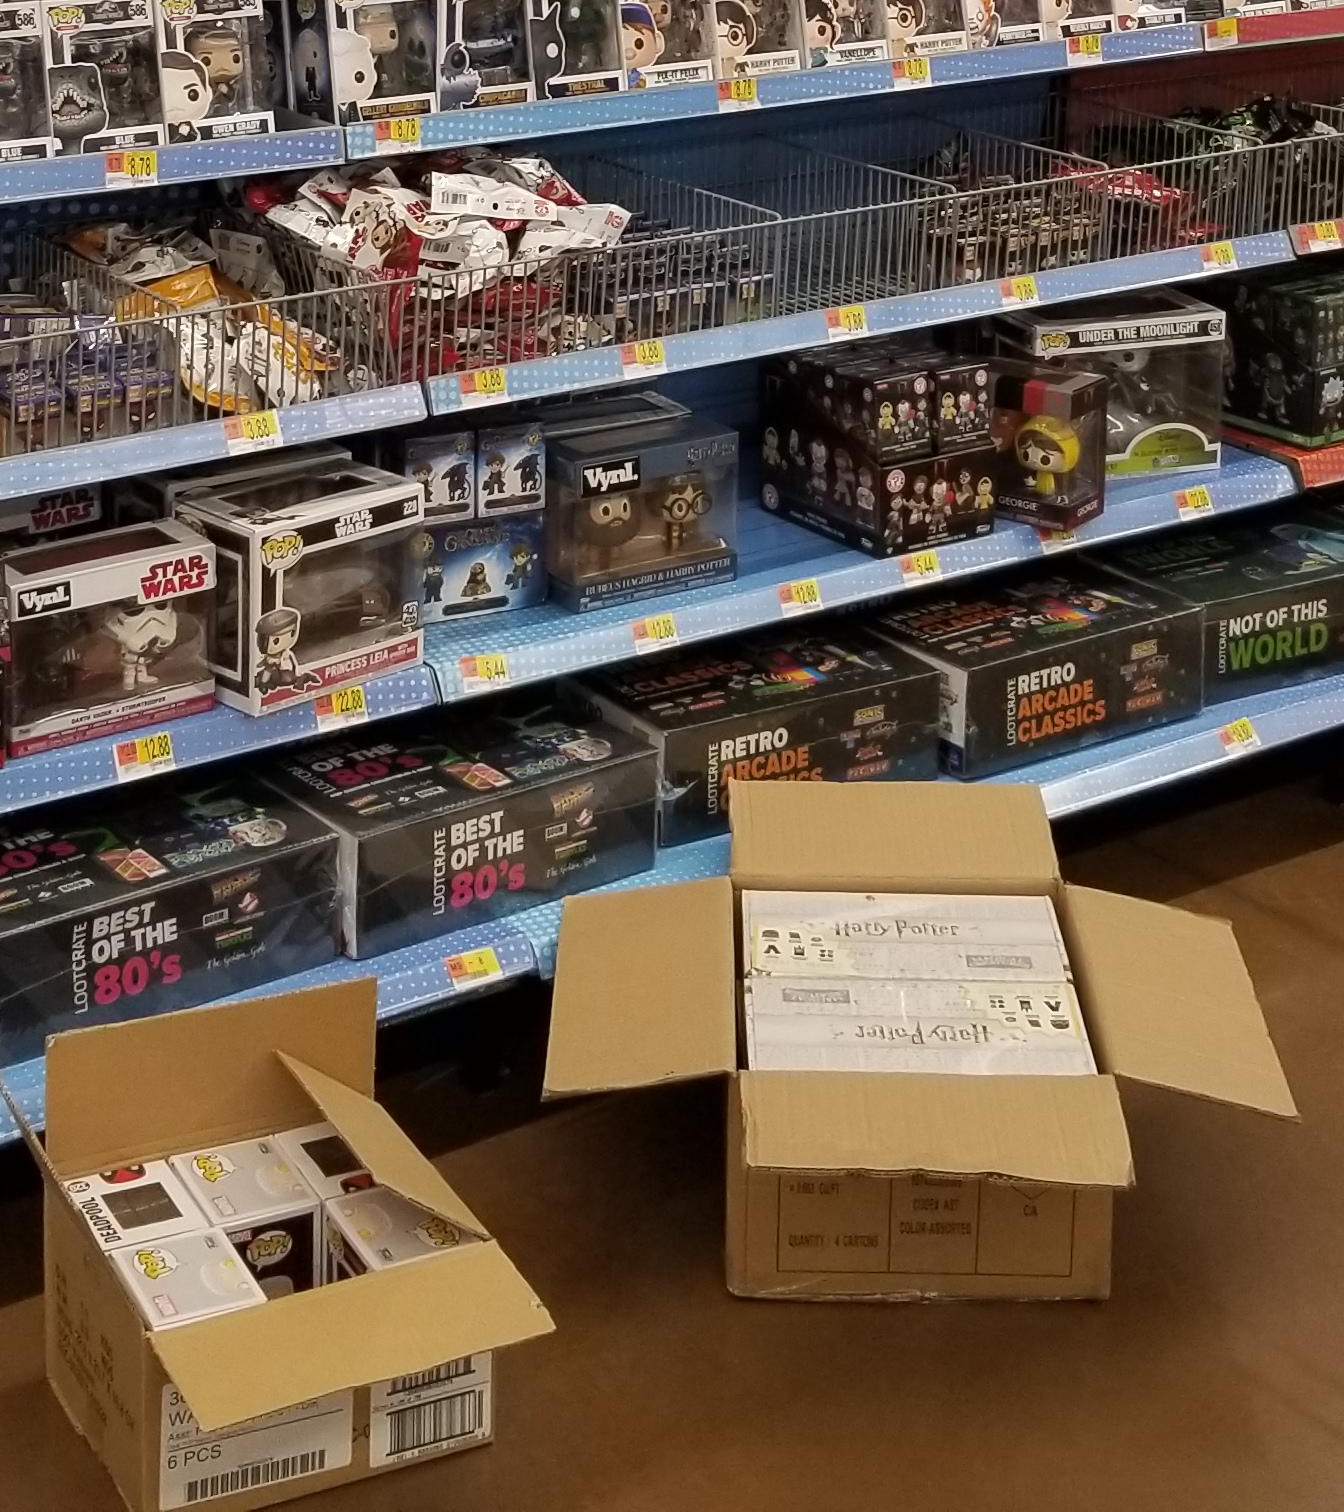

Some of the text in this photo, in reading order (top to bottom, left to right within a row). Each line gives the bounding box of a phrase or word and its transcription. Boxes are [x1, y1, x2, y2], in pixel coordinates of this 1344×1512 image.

[129, 155, 152, 176] 8.78
[1079, 322, 1200, 343] UNDER THE MOONLIGHT
[248, 418, 270, 439] 3.88
[584, 461, 638, 492] Vynl.
[999, 496, 1039, 511] GEORGIE
[141, 554, 209, 581] STAR
[696, 558, 731, 574] POTTER
[20, 584, 71, 612] Vynl.
[141, 571, 209, 600] WARS
[1229, 599, 1329, 637] NOT OF THIS
[325, 649, 389, 679] PRINCESS LEIA
[1218, 618, 1228, 675] LOOTCRATE
[1229, 622, 1329, 671] WORLD
[1017, 662, 1076, 696] RETRO
[1006, 677, 1017, 746] LOOTCRATE
[1018, 679, 1095, 720] ARCADE
[1018, 700, 1107, 744] CLASSICS
[145, 737, 171, 760] 12.88
[720, 727, 788, 761] RETRO
[707, 741, 719, 815] LOOTCRATE
[721, 744, 810, 781] ARCADE
[451, 810, 505, 846] BEST
[451, 828, 525, 871] OF THE
[433, 827, 446, 916] LOOTCRATE
[450, 860, 526, 908] 80's
[92, 901, 156, 937] BEST
[92, 918, 178, 965] OF THE
[73, 921, 89, 1015] LOOTCRATE
[93, 950, 183, 1006] 80's
[81, 1193, 122, 1245] DEADPOOL
[167, 1444, 222, 1471] 6 PCS
